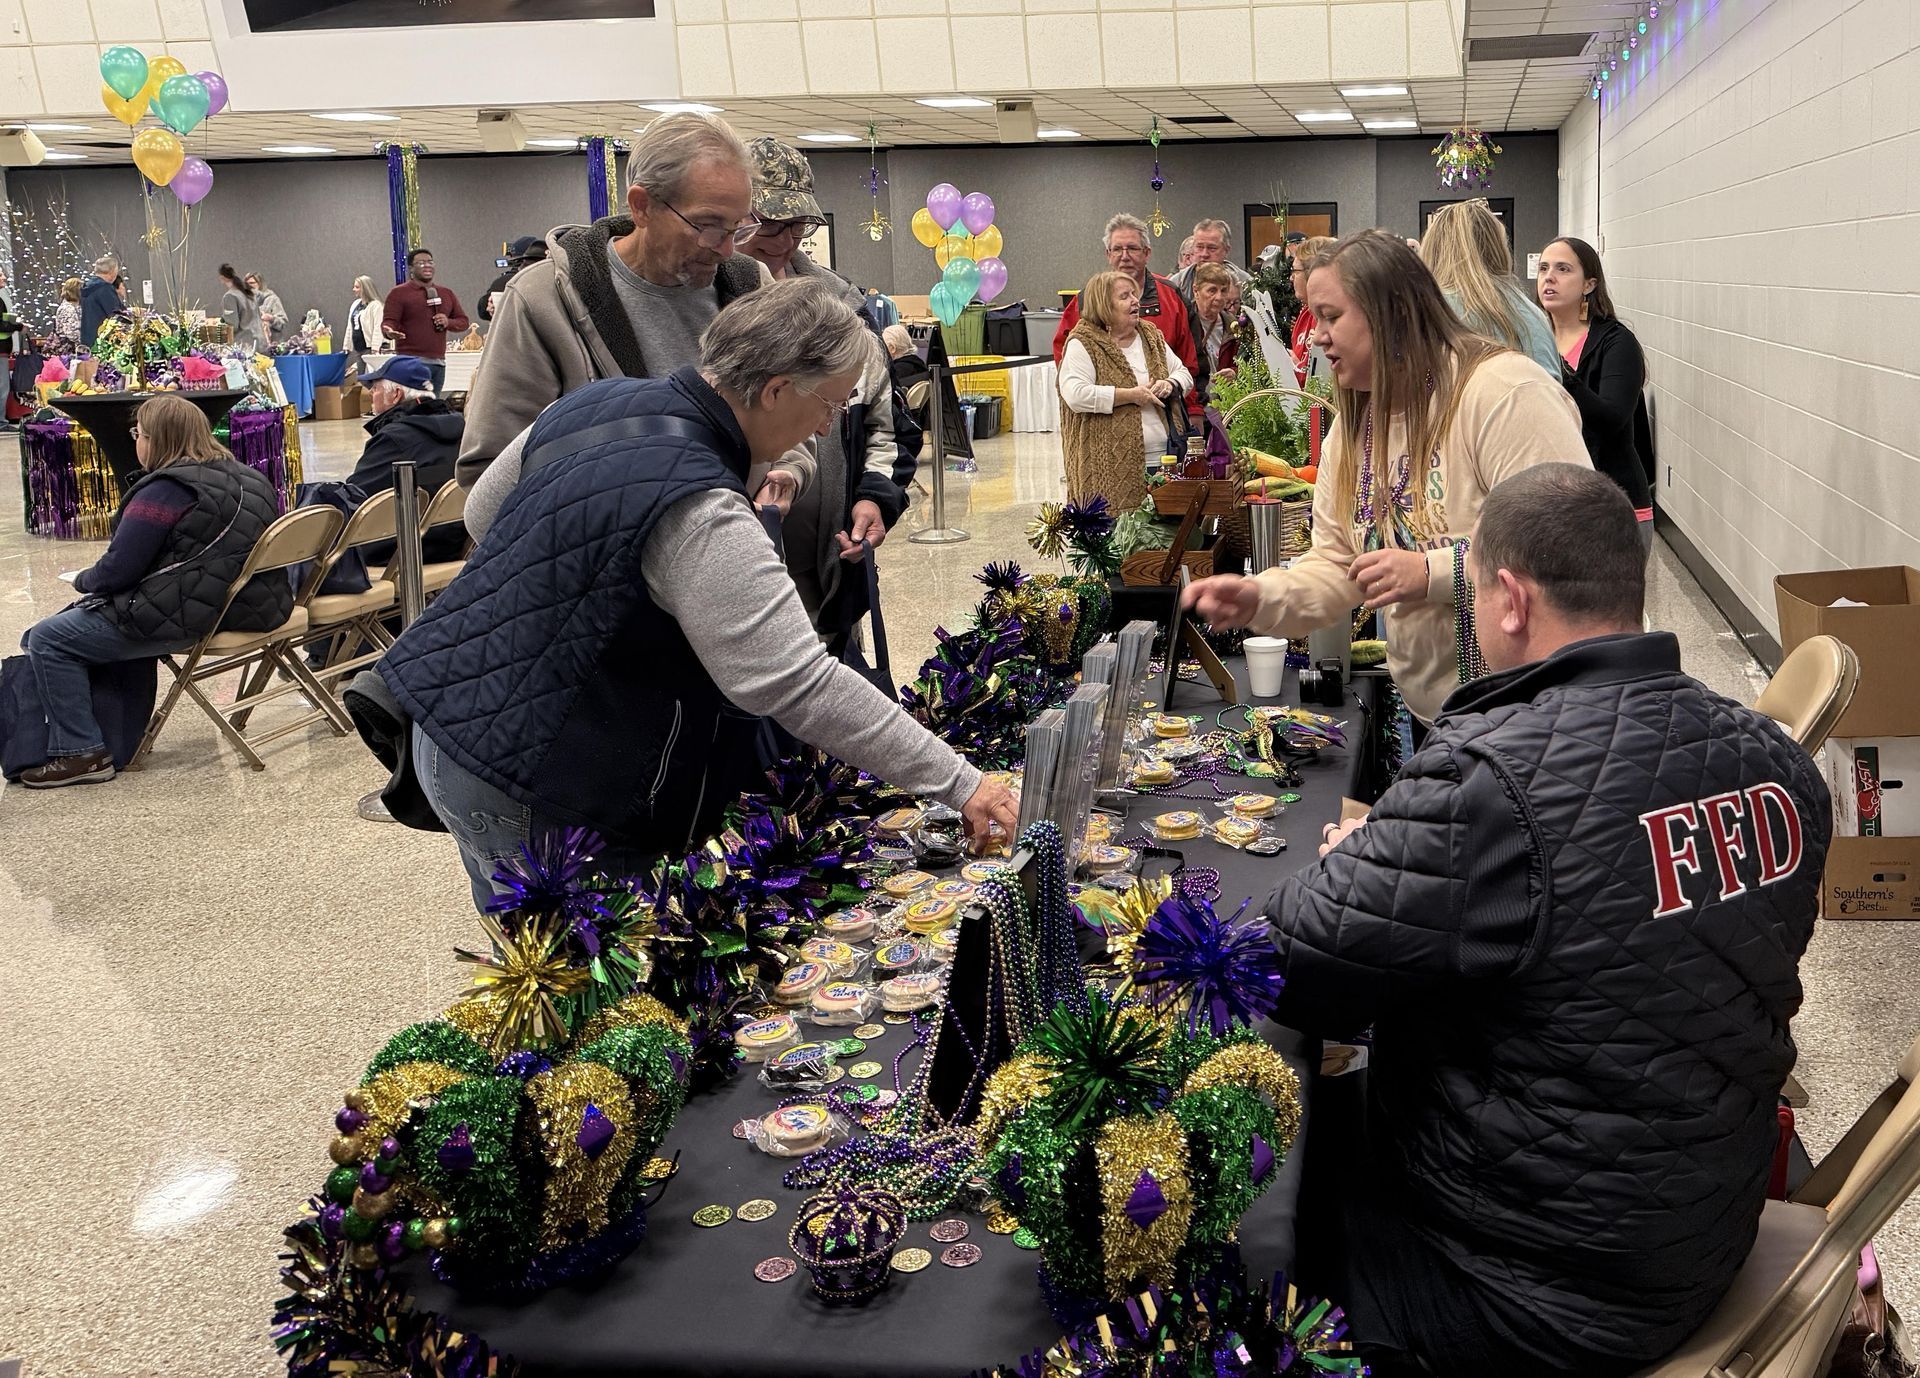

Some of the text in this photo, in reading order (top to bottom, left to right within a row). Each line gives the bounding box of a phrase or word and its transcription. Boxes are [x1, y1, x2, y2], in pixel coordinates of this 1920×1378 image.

[1857, 759, 1874, 792] USA
[1638, 781, 1803, 919] FFD
[1833, 886, 1894, 901] Southern's
[1858, 901, 1879, 911] Best
